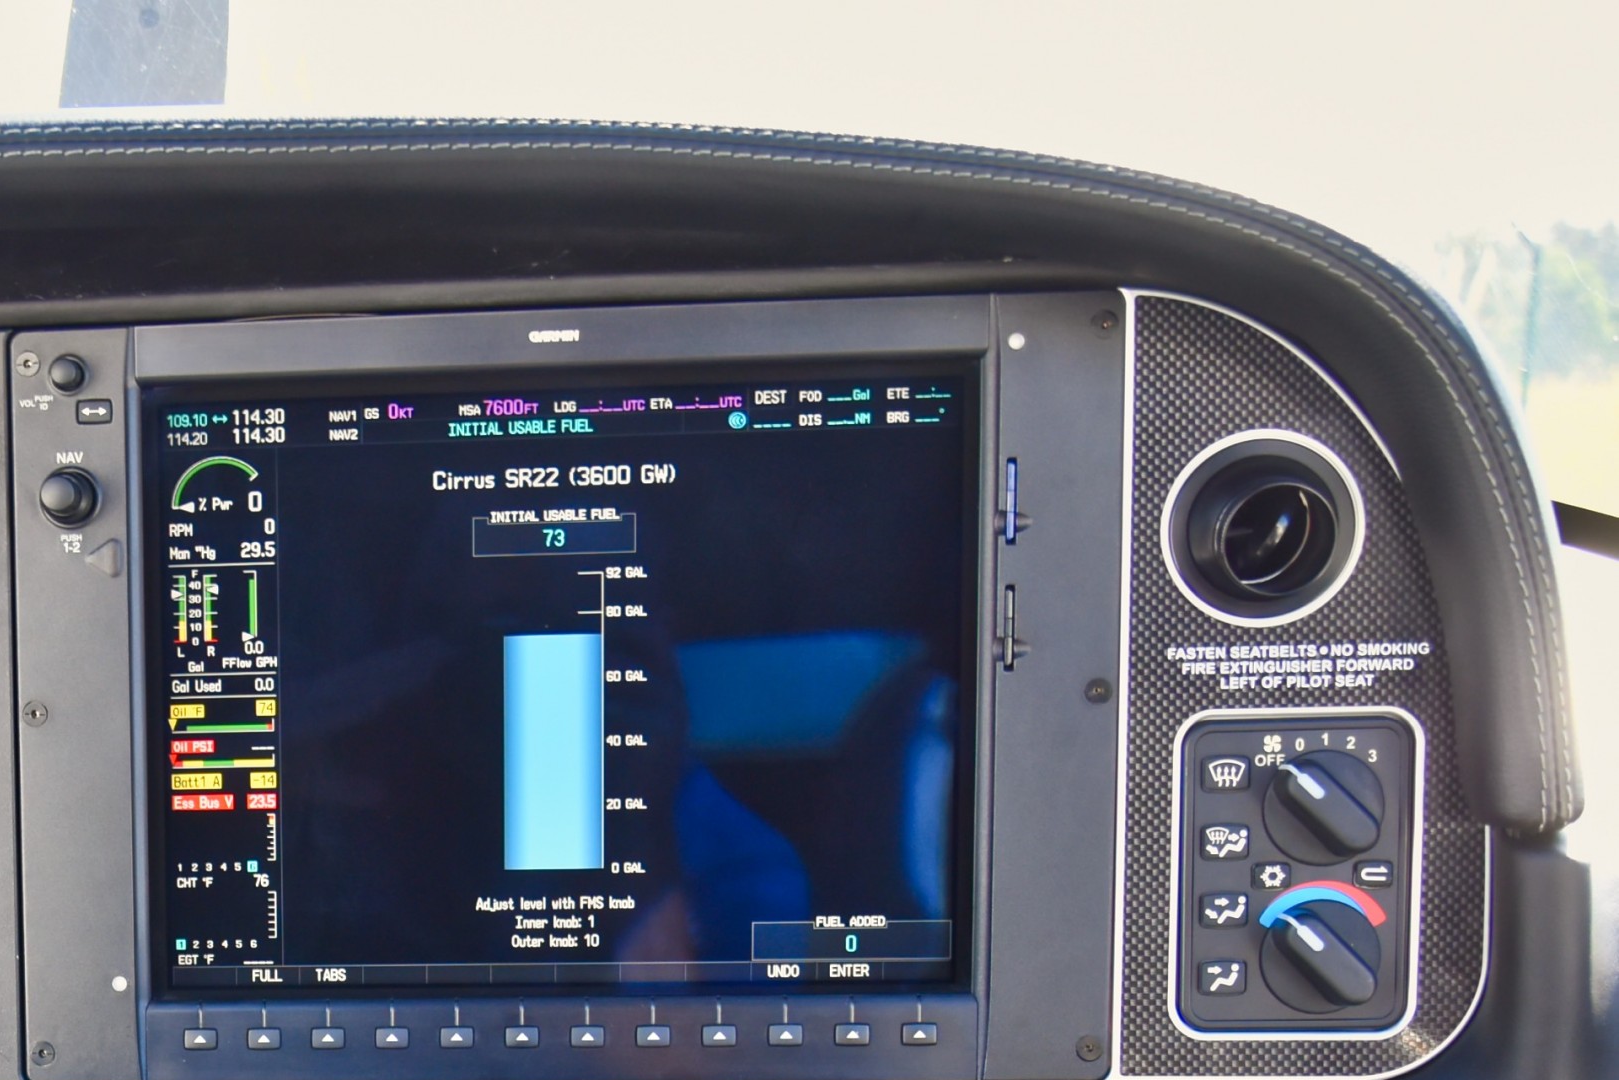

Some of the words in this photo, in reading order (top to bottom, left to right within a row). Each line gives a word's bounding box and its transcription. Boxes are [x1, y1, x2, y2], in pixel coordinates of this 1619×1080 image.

[528, 330, 580, 343] GARMIN
[755, 390, 787, 405] DEST
[166, 413, 208, 428] 109.10
[233, 408, 285, 425] 114.30
[329, 410, 357, 423] NAV1
[448, 422, 503, 437] INITIAL
[508, 419, 557, 435] USABLE
[561, 418, 594, 433] FUEL
[167, 432, 208, 446] 114.20
[233, 427, 286, 444] 114.30
[329, 428, 359, 441] NAV2
[56, 451, 83, 465] NAV
[432, 470, 495, 491] Cirrus
[505, 467, 559, 488] SR22
[568, 465, 631, 487] (3600
[640, 463, 676, 485] GW)
[542, 528, 565, 547] 73
[240, 541, 276, 559] 29.5
[1167, 646, 1227, 660] FASTEN
[1229, 644, 1317, 659] SEATBELTS
[1331, 643, 1354, 657] NO
[1357, 642, 1430, 656] SMOKING
[1181, 661, 1216, 675] FIRE
[1219, 659, 1333, 674] EXTINGUISHER
[1336, 658, 1414, 672] FORWARD
[1220, 677, 1257, 690] LEFT
[1261, 675, 1282, 689] OF
[1286, 675, 1331, 688] PILOT
[1335, 673, 1374, 687] SEAT
[1254, 753, 1286, 767] OFF
[475, 897, 514, 912] Adjust
[520, 897, 546, 911] level
[552, 897, 575, 910] with
[579, 896, 604, 909] FMS
[608, 896, 635, 909] knob
[815, 916, 845, 928] FUEL
[849, 915, 886, 927] ADDED
[511, 934, 544, 948] Outer
[549, 934, 578, 947] knob:
[584, 933, 600, 947] 10
[251, 968, 283, 983] FULL
[315, 968, 347, 982] TABS
[767, 964, 800, 978] UNDO
[829, 963, 870, 978] ENTER
